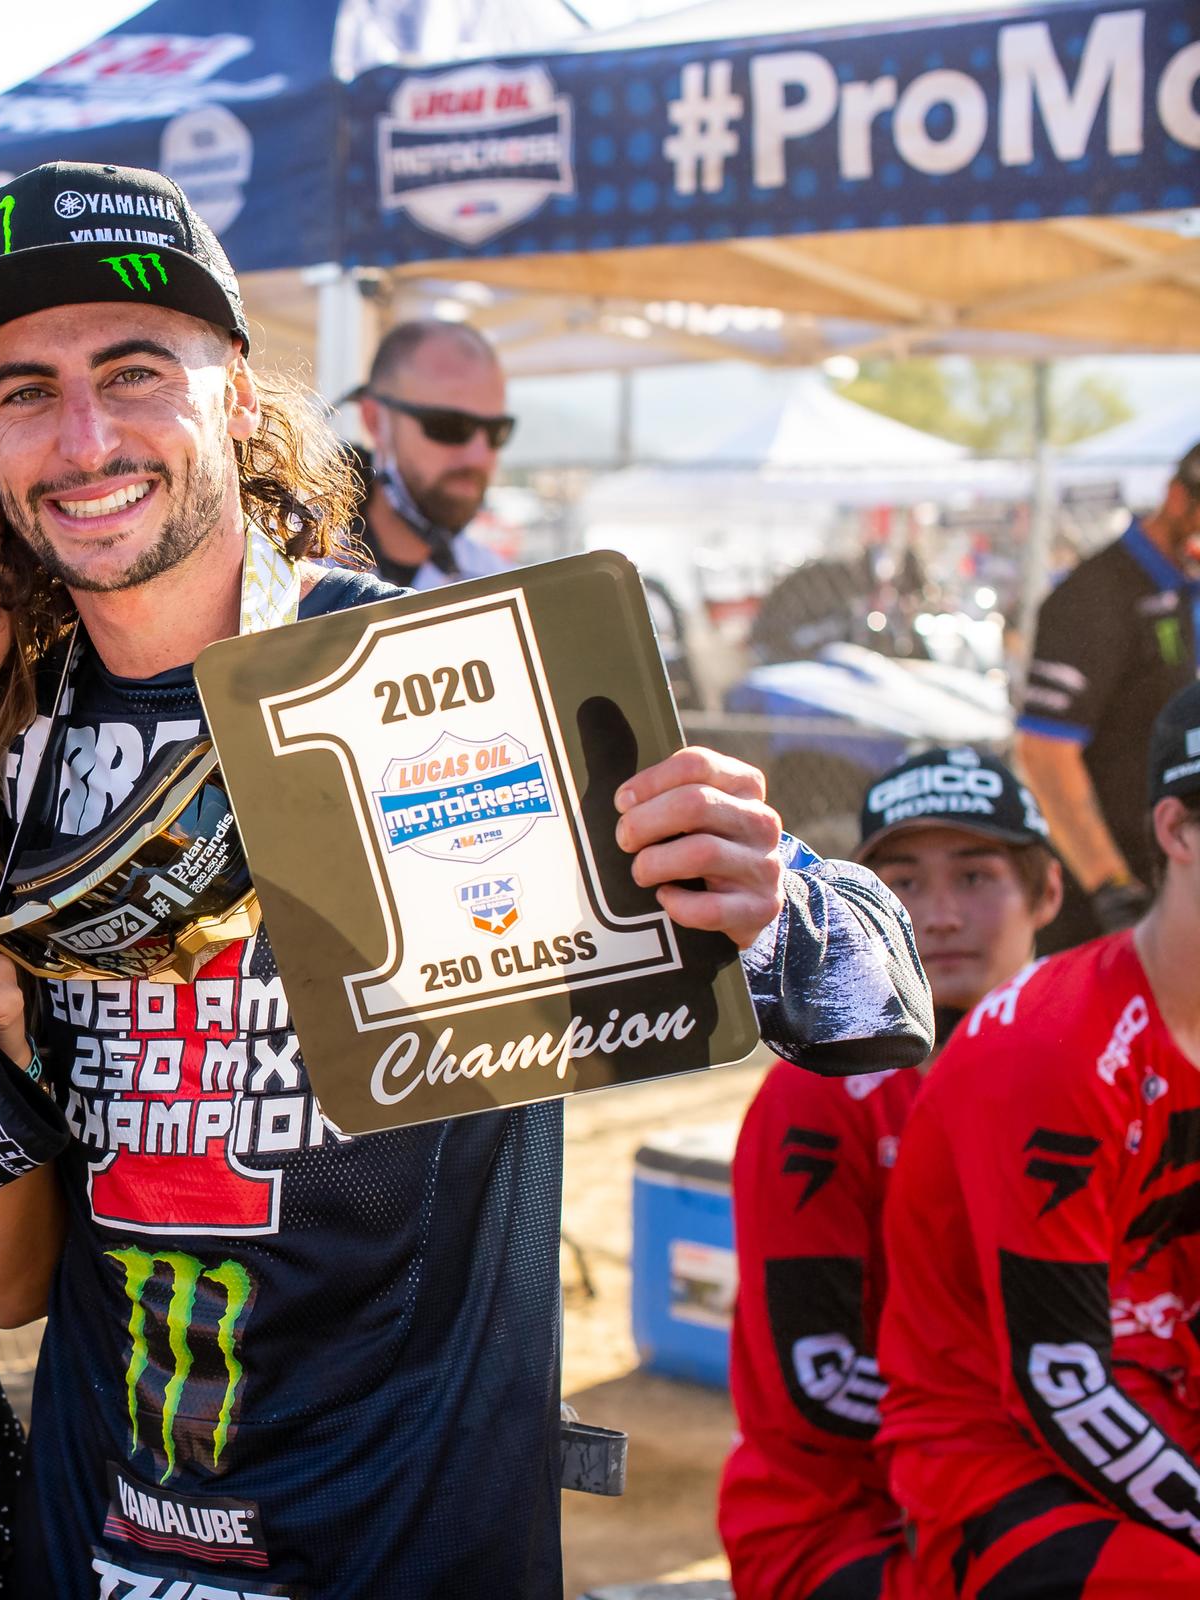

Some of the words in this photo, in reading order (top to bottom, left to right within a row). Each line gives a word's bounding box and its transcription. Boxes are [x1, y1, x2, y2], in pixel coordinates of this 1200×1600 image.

[86, 193, 180, 222] YAMAHA
[373, 658, 496, 725] 2020
[399, 753, 469, 788] LUCAS
[475, 745, 511, 771] OIL
[440, 783, 483, 799] PRO
[869, 764, 1003, 814] GEICO
[385, 778, 546, 830] MOTOCROSS
[389, 796, 549, 838] CHAMPIONSHIP
[885, 795, 995, 826] HONDA
[167, 836, 208, 879] Dylan
[177, 813, 234, 886] Ferrandis
[450, 833, 484, 850] AMA
[484, 829, 502, 839] PRO
[189, 871, 207, 891] 2020
[205, 858, 218, 873] 250
[216, 841, 230, 858] MX
[194, 855, 229, 893] Champion
[67, 913, 140, 950] 100%
[420, 956, 482, 993] 250
[491, 931, 598, 977] CLASS
[47, 978, 177, 1031] 2020
[195, 976, 290, 1031] AM
[71, 1035, 185, 1092] 250
[201, 1034, 301, 1092] MX
[369, 1003, 697, 1106] Champion
[1027, 1341, 1200, 1545] GEIC
[117, 1475, 254, 1545] YAMALUBE
